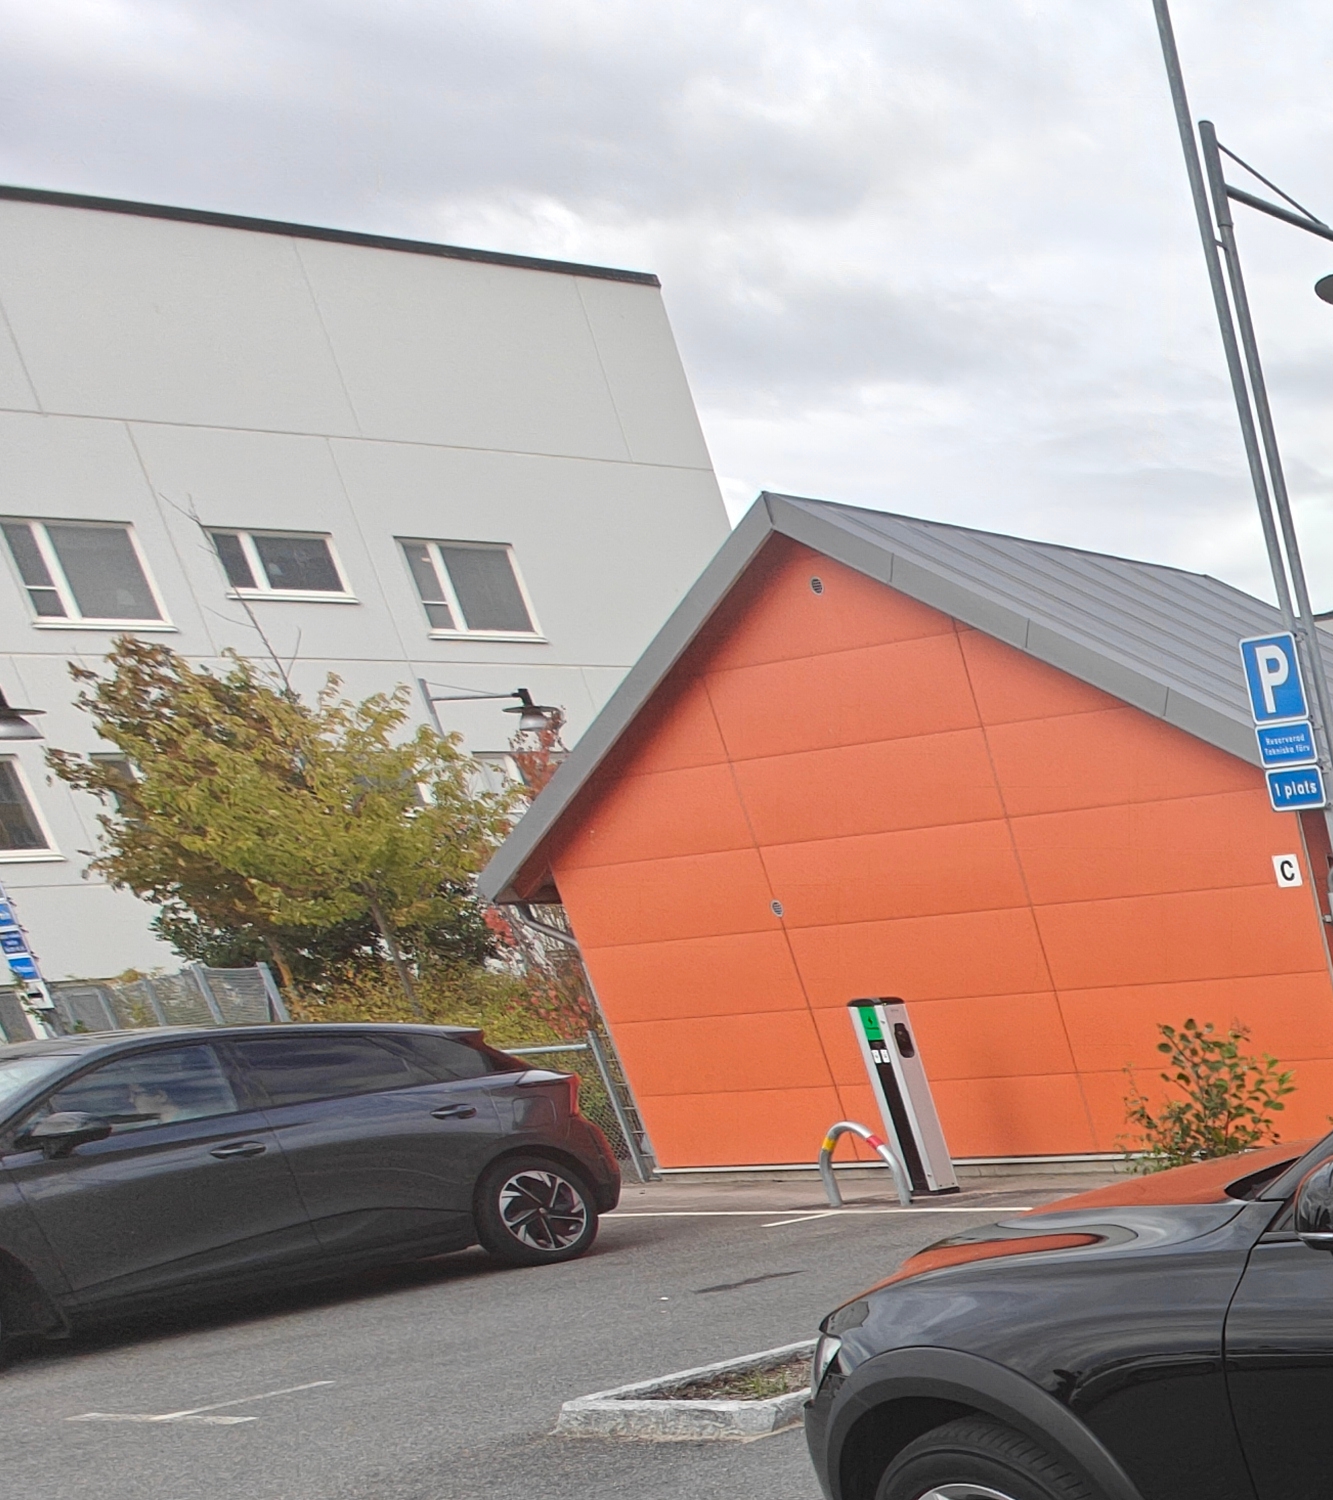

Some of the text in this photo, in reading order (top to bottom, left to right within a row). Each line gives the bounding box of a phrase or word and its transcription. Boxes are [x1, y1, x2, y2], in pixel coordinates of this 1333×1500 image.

[1255, 645, 1289, 713] P
[1274, 781, 1317, 799] 1 plats
[1280, 860, 1295, 881] C
